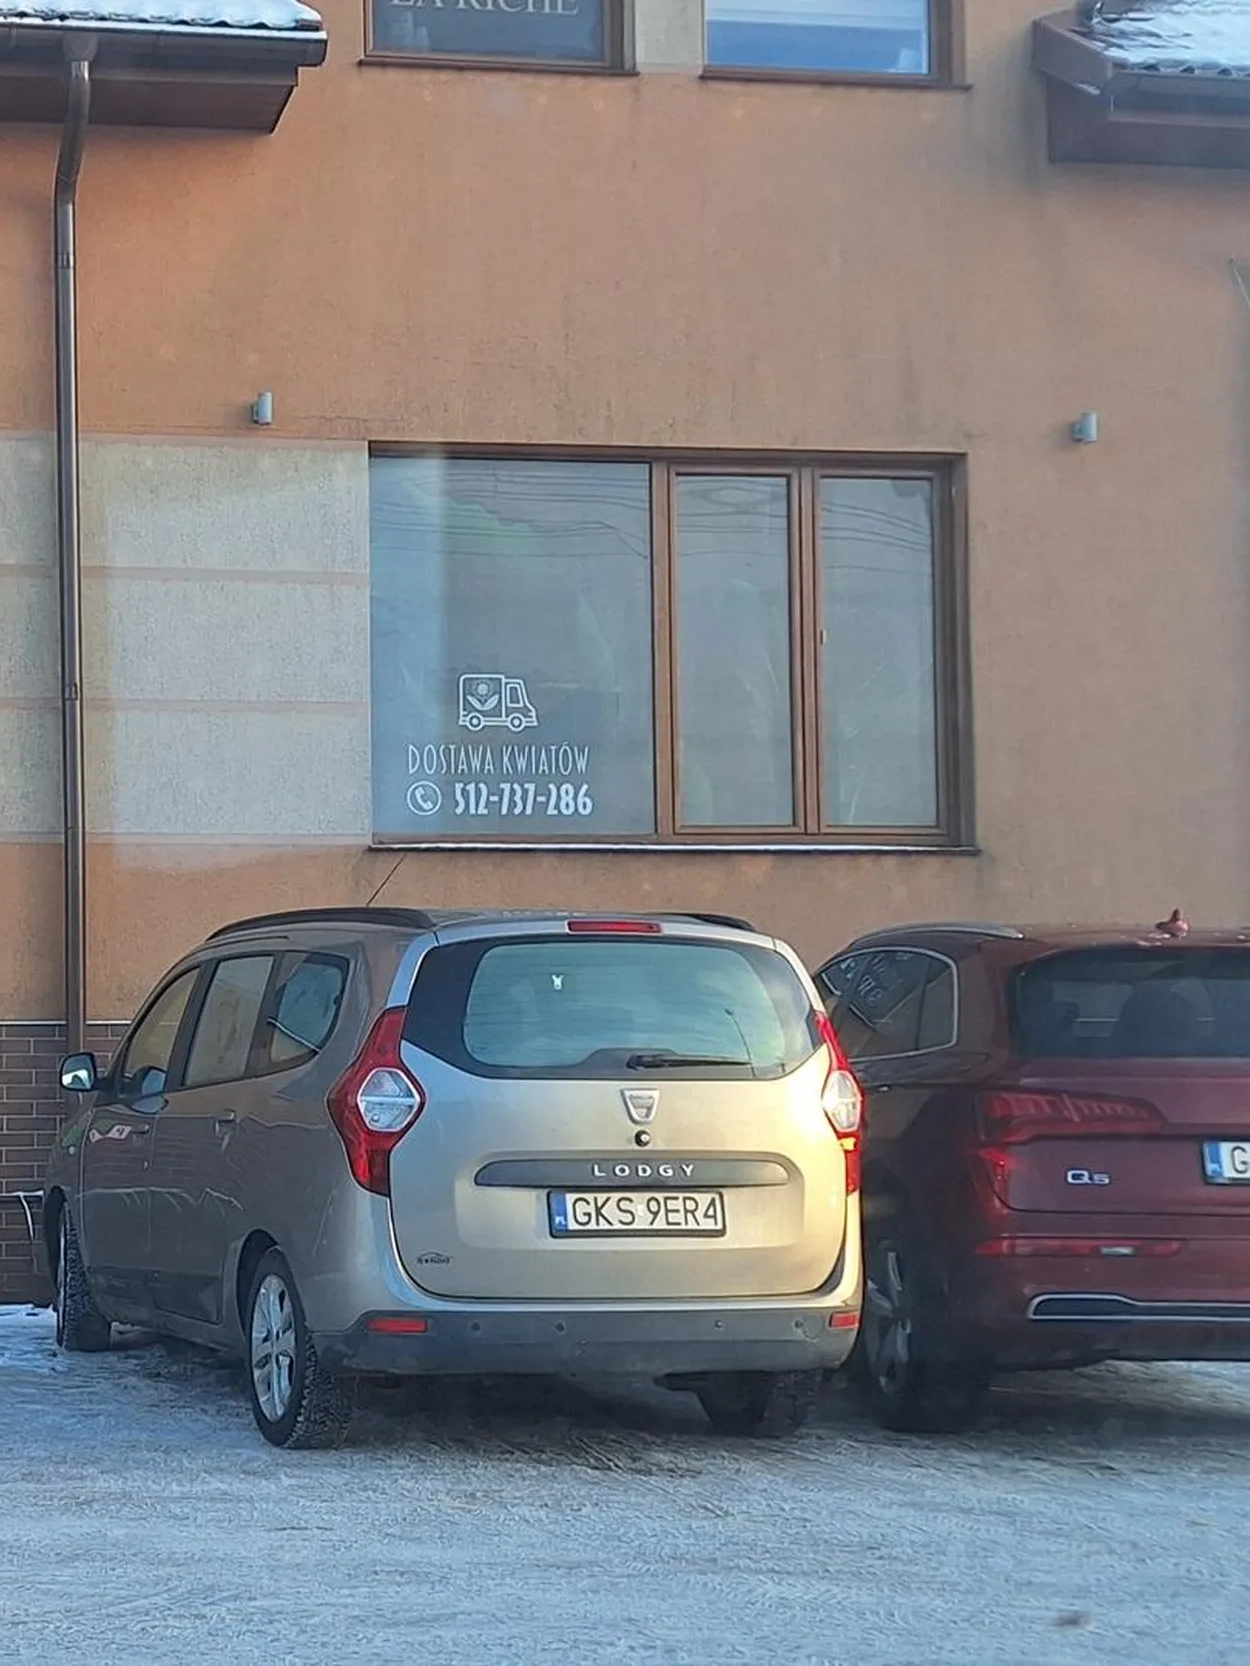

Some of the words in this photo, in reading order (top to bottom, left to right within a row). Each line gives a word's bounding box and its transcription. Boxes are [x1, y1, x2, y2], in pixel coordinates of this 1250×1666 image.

[408, 744, 494, 775] DOSTAWA
[502, 741, 590, 775] KWIATÓW
[454, 781, 593, 816] 512-737-286
[592, 1163, 697, 1178] LODGY
[1066, 1169, 1111, 1185] Q5
[571, 1196, 636, 1227] GKS
[646, 1196, 719, 1227] 9ER4
